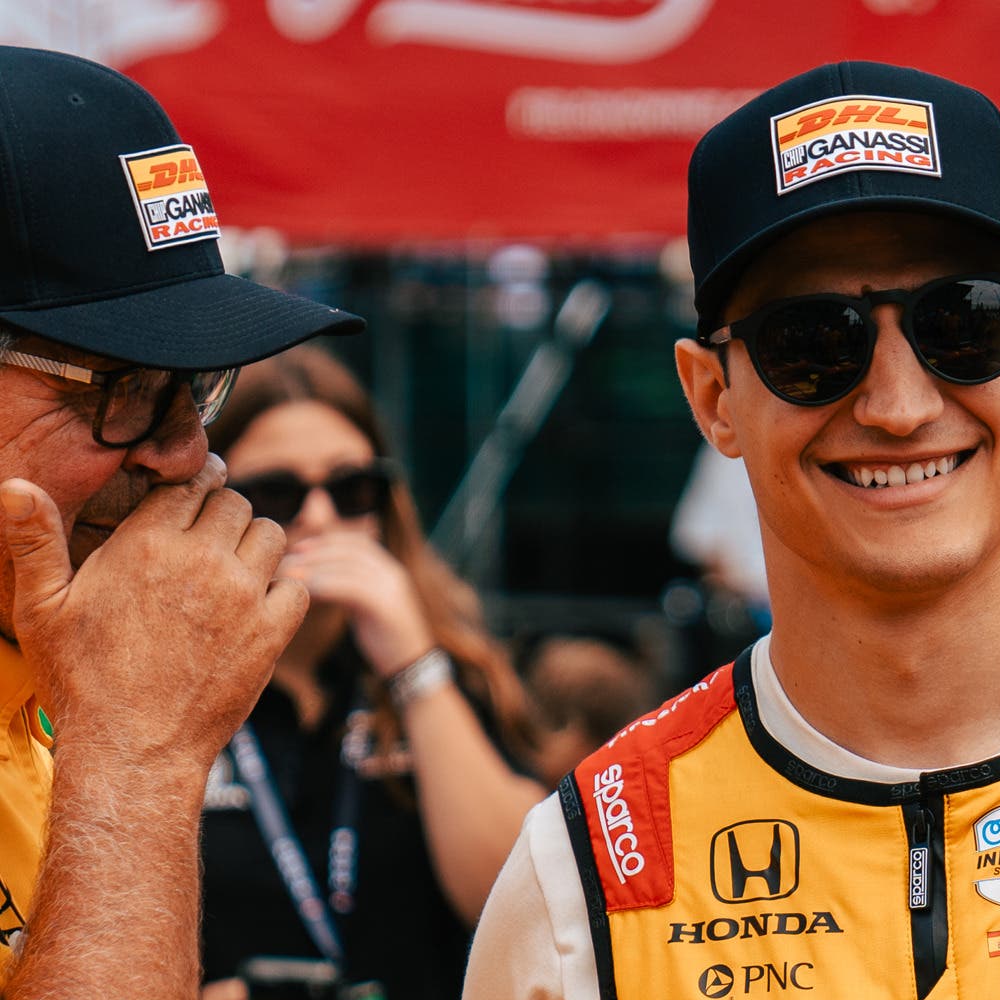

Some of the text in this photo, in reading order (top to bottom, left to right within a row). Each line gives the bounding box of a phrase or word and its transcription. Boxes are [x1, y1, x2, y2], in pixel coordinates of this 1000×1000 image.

[797, 105, 908, 137] DHL
[783, 131, 930, 171] CHIP GANASSI
[785, 150, 931, 184] RACING
[593, 764, 644, 884] sparco
[912, 851, 925, 905] sparco
[667, 912, 844, 944] HONDA
[741, 962, 814, 994] PNC
